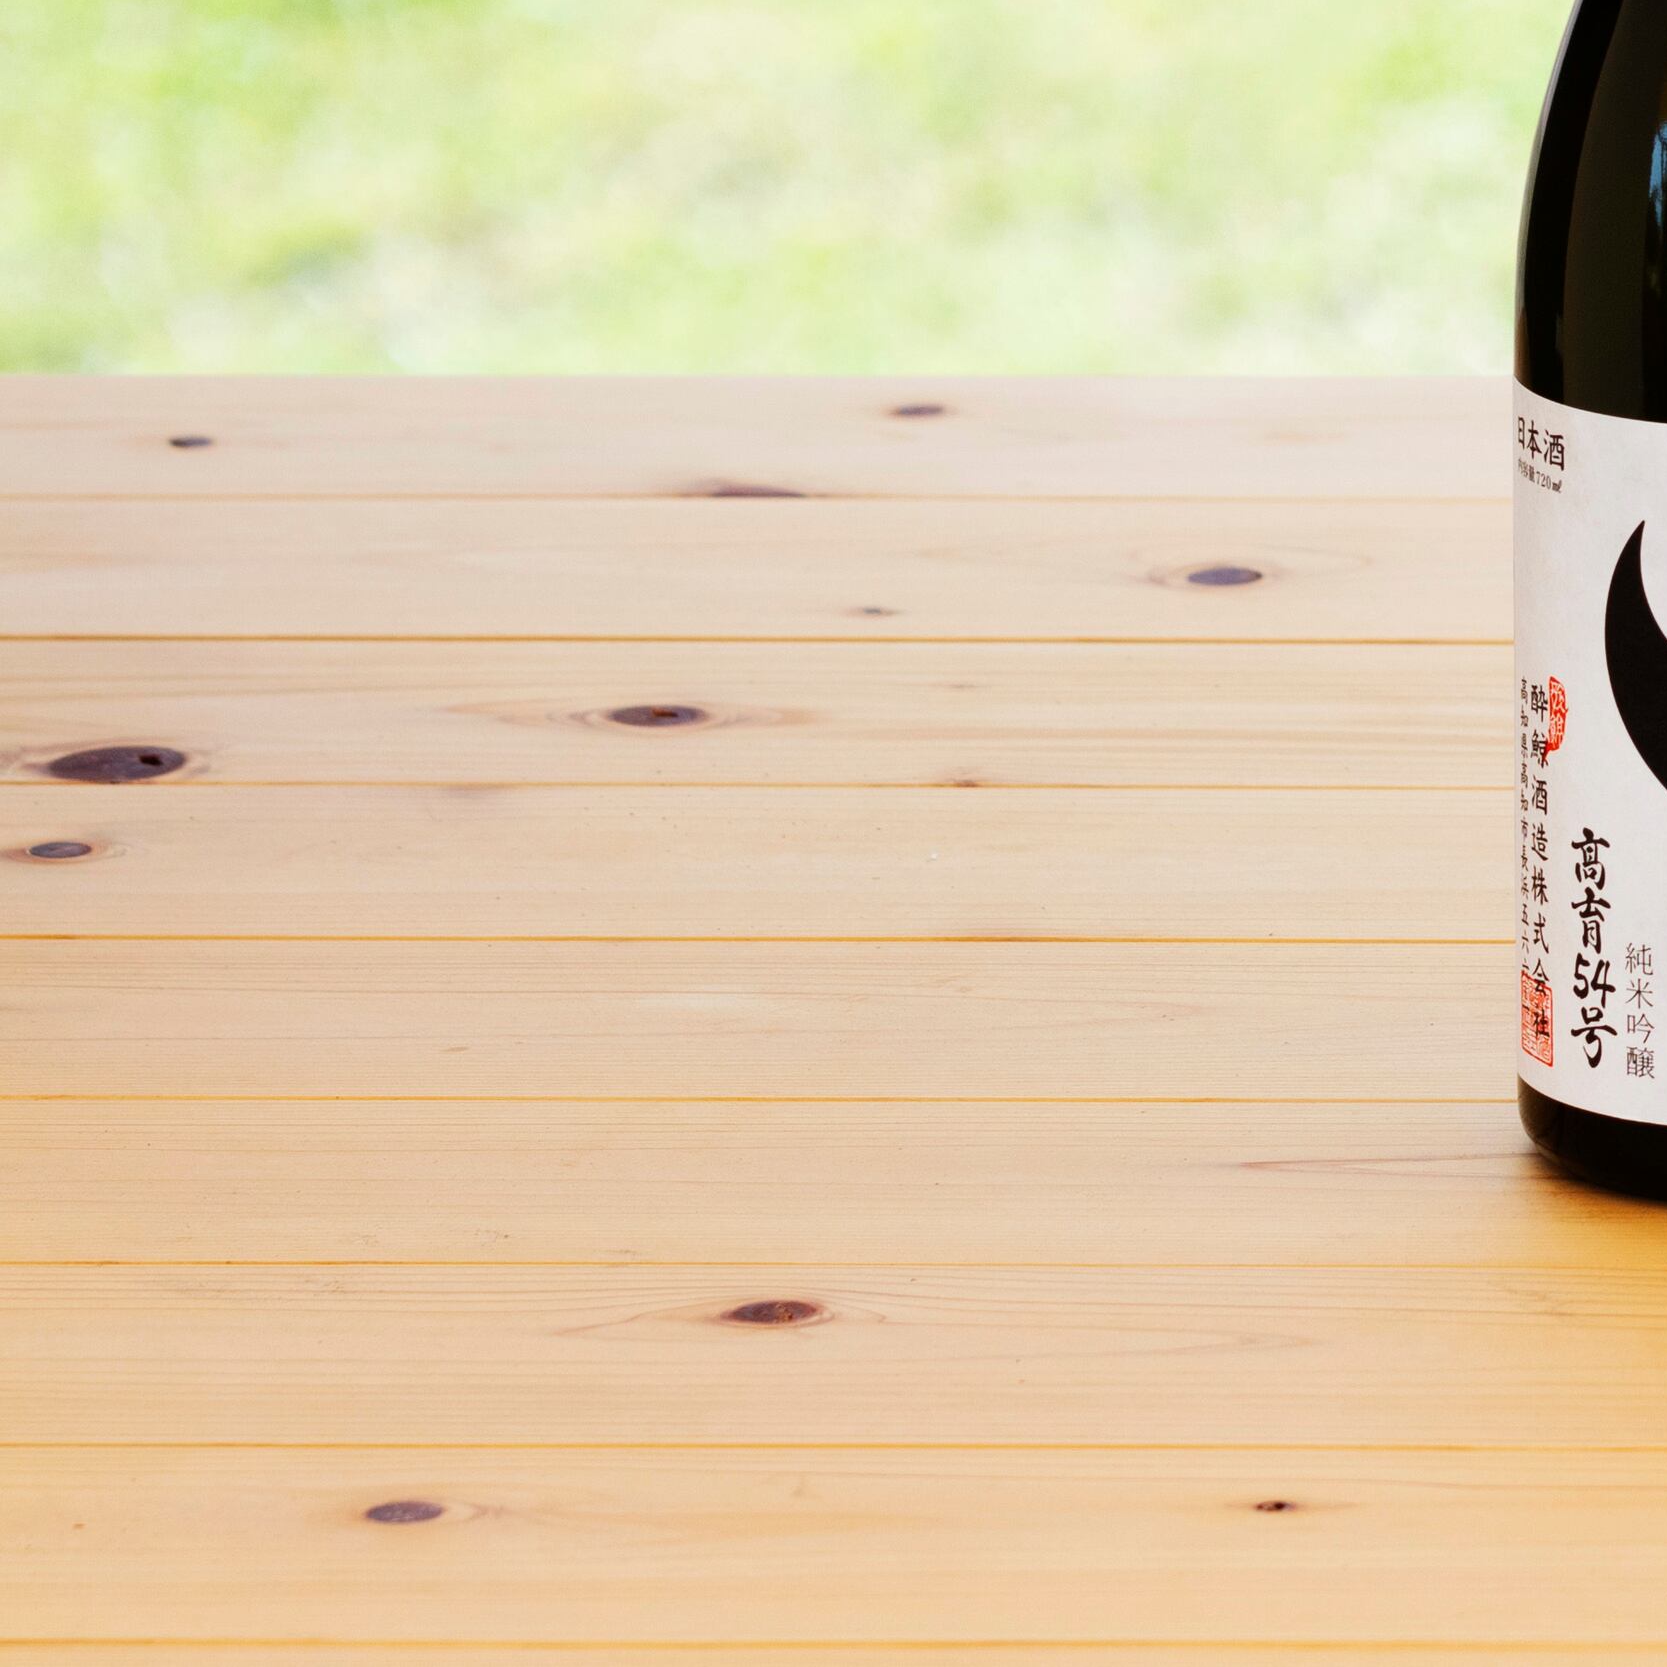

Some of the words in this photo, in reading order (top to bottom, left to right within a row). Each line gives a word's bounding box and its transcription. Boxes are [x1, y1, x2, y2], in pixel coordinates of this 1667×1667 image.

[1517, 416, 1565, 471] 日本酒
[1571, 827, 1618, 1069] 高育54号
[1624, 942, 1656, 1080] 純米吟醸
